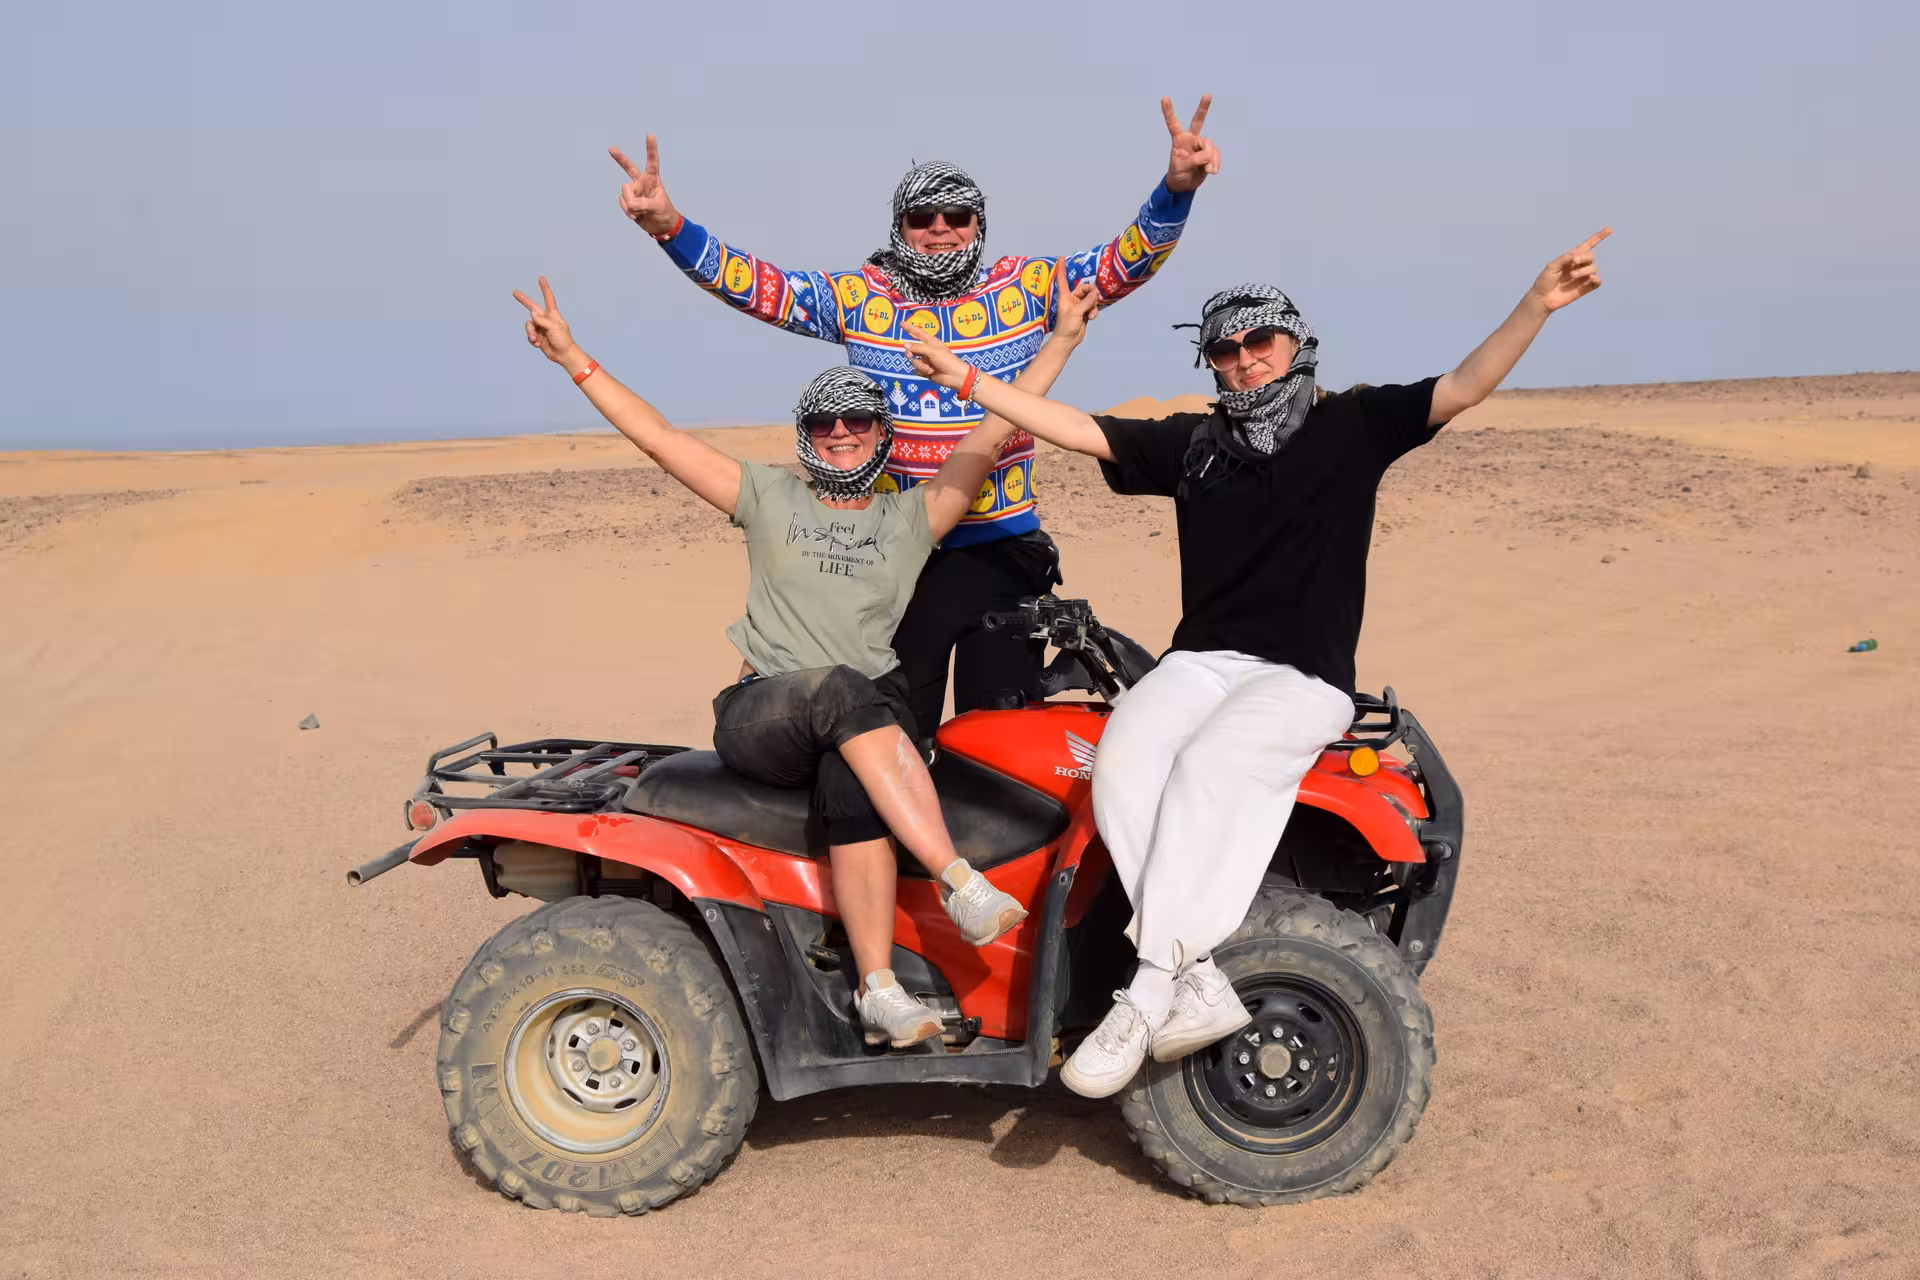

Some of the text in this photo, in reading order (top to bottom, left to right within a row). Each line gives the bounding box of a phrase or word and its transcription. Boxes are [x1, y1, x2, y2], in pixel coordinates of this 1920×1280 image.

[829, 521, 856, 535] Feel
[812, 551, 826, 559] THE
[827, 553, 865, 565] MOVEMENT
[819, 560, 855, 577] LIFE
[1054, 765, 1093, 780] HON
